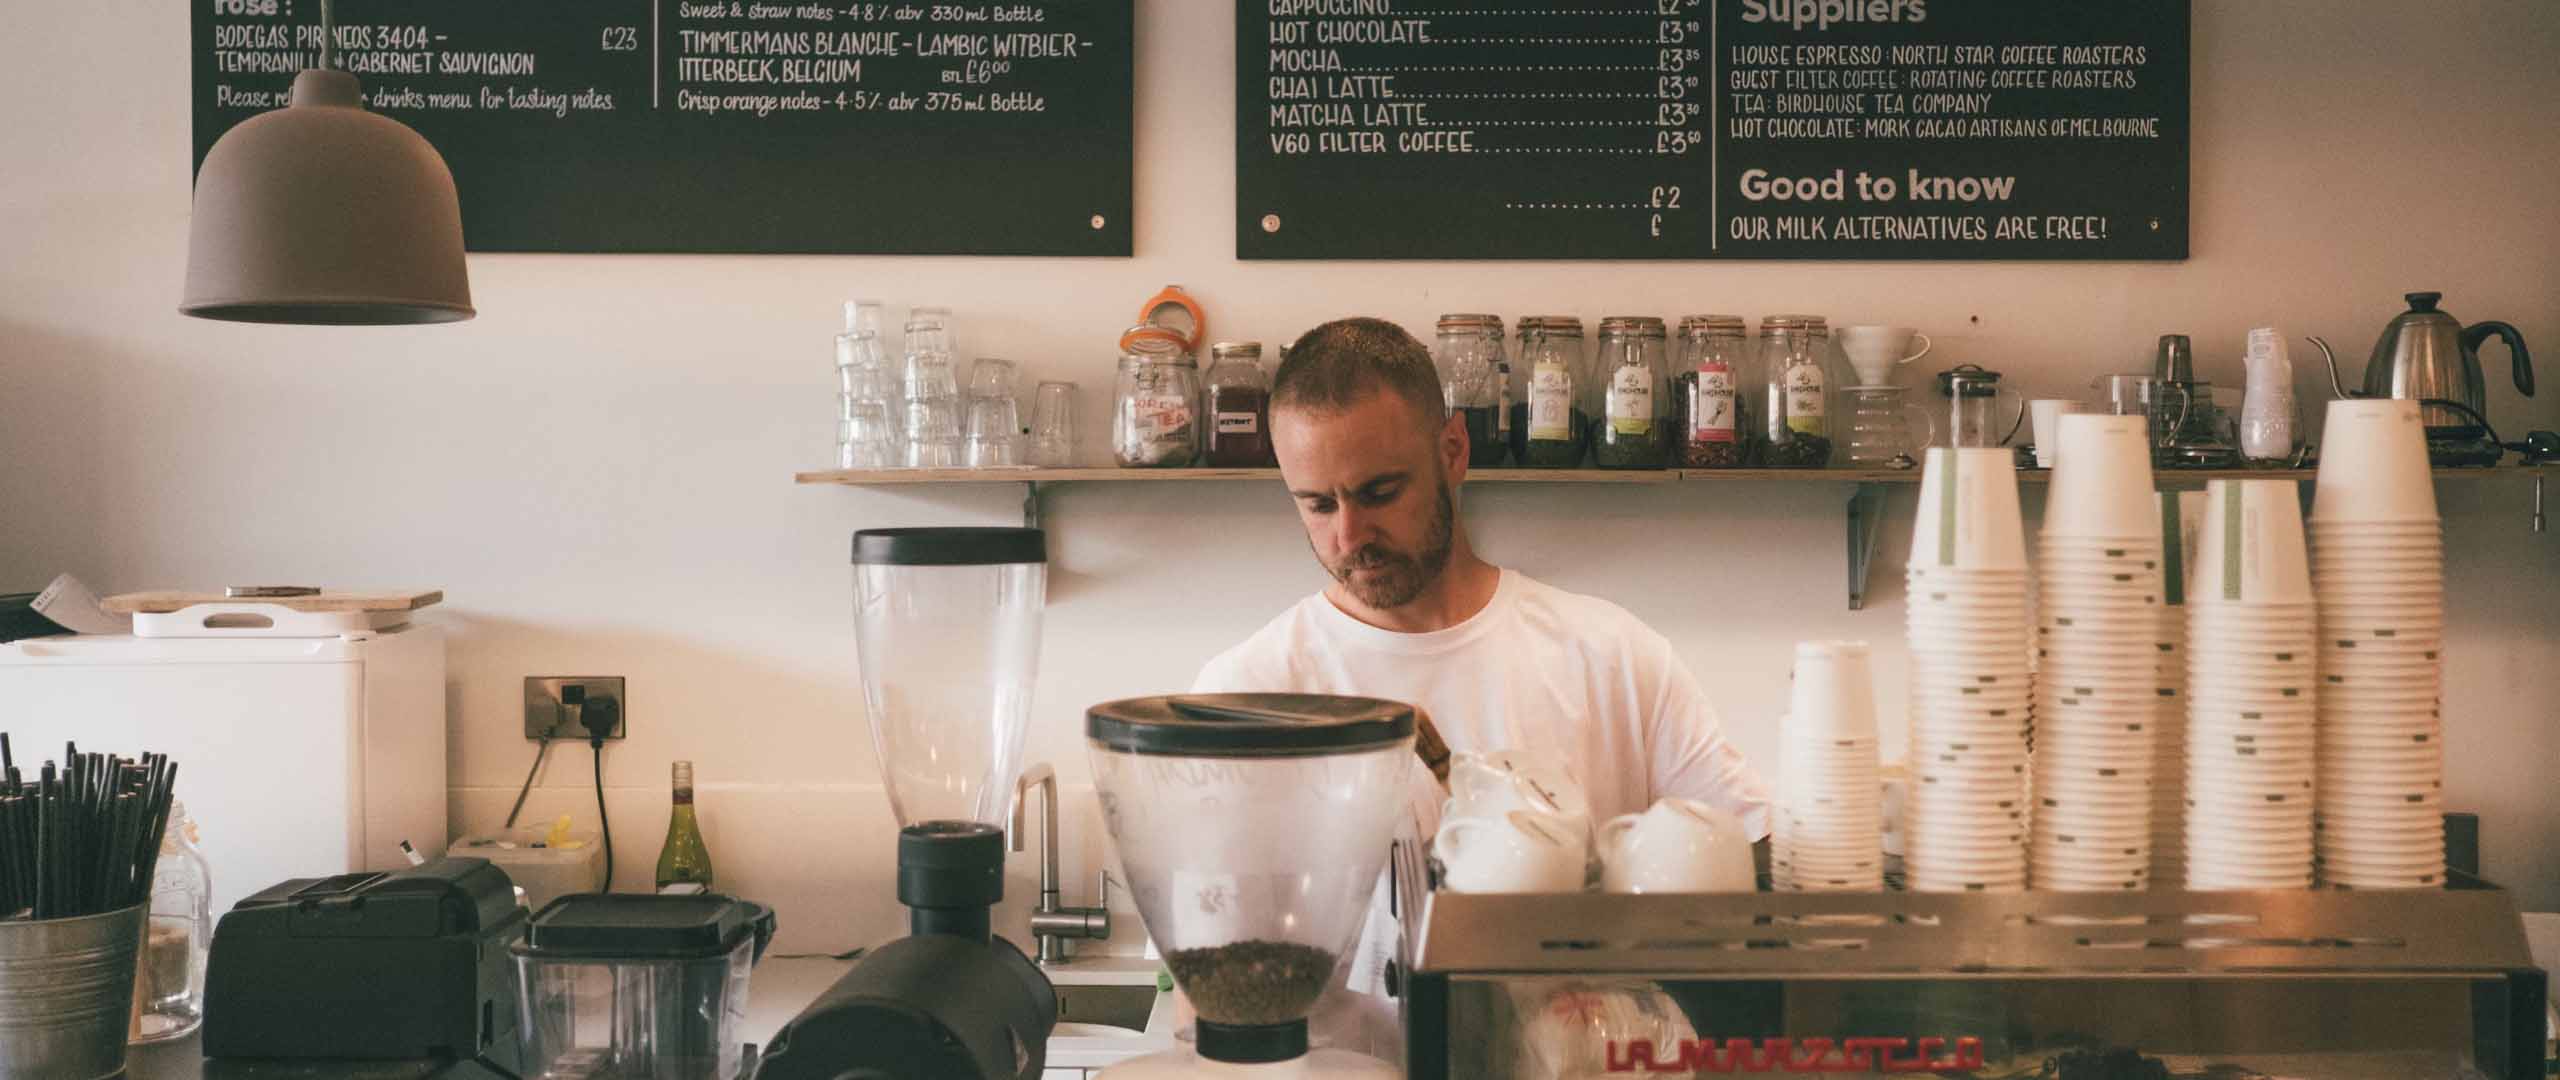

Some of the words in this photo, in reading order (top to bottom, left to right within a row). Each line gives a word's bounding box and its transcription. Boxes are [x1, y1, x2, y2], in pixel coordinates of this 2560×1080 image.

[679, 0, 728, 19] Sweet
[729, 1, 744, 18] &
[747, 1, 793, 20] straw
[796, 2, 834, 22] notes
[894, 4, 924, 21] abv
[993, 4, 1045, 23] Bottle
[1741, 0, 1926, 31] Suppliers
[215, 24, 289, 49] BODEGAS
[296, 24, 372, 50] PIRNEOS
[376, 25, 429, 50] 3404
[601, 26, 638, 51] £23
[679, 29, 811, 56] TIMMERMANS
[814, 31, 900, 57] BLANCHE
[916, 31, 989, 57] LAMBIC
[993, 32, 1077, 58] WITBIER
[1269, 20, 1310, 44] HOT
[1316, 19, 1431, 44] CHOCOLATE
[348, 50, 435, 74] CABERNET
[438, 51, 535, 76] SAUVIGNON
[1269, 48, 1342, 73] MOCHA
[1732, 45, 1791, 66] HOUSE
[1892, 45, 1948, 65] NORTH
[1954, 45, 1995, 65] STAR
[2001, 45, 2058, 65] COFFEE
[2062, 45, 2146, 65] ROASTERS
[678, 56, 780, 85] ITTERBEEK,
[782, 58, 861, 84] BELGIUM
[941, 69, 964, 84] BTL
[1730, 69, 1780, 90] GUEST
[1786, 69, 1839, 90] FILTER
[1910, 70, 1987, 89] ROTATING
[1991, 69, 2047, 89] COFFEE
[2052, 69, 2137, 89] ROASTERS
[1269, 76, 1318, 100] CHAI
[1328, 75, 1399, 99] LATTE
[217, 84, 271, 108] Please
[372, 85, 426, 109] drinks
[427, 93, 473, 110] menu
[479, 85, 505, 110] for
[507, 86, 568, 119] tasting
[677, 88, 721, 116] Crisp
[722, 95, 779, 118] orange
[780, 89, 821, 111] notes
[887, 91, 920, 111] abv
[990, 91, 1045, 112] Bottle
[1777, 93, 1865, 114] BIRDHOUSE
[1874, 93, 1905, 114] TEA
[1912, 93, 1992, 114] COMPANY
[1270, 103, 1356, 128] MATCHA
[1363, 102, 1429, 127] LATTE
[1730, 117, 1764, 139] HOT
[1865, 118, 1911, 138] MORK
[1915, 118, 1967, 139] CACAO
[1969, 118, 2048, 138] ARTISANS
[2070, 117, 2159, 138] MELBOURNE
[1270, 132, 1311, 155] V60
[1319, 131, 1387, 153] FILTER
[1398, 130, 1480, 153] COFFEE
[1739, 168, 1845, 201] Good
[1855, 171, 1897, 202] to
[1908, 168, 2016, 202] know
[1730, 215, 1772, 241] OUR
[1776, 215, 1828, 241] MILK
[1833, 215, 1988, 241] ALTERNATIVES
[1994, 215, 2039, 240] ARE
[2045, 215, 2107, 240] FREE!
